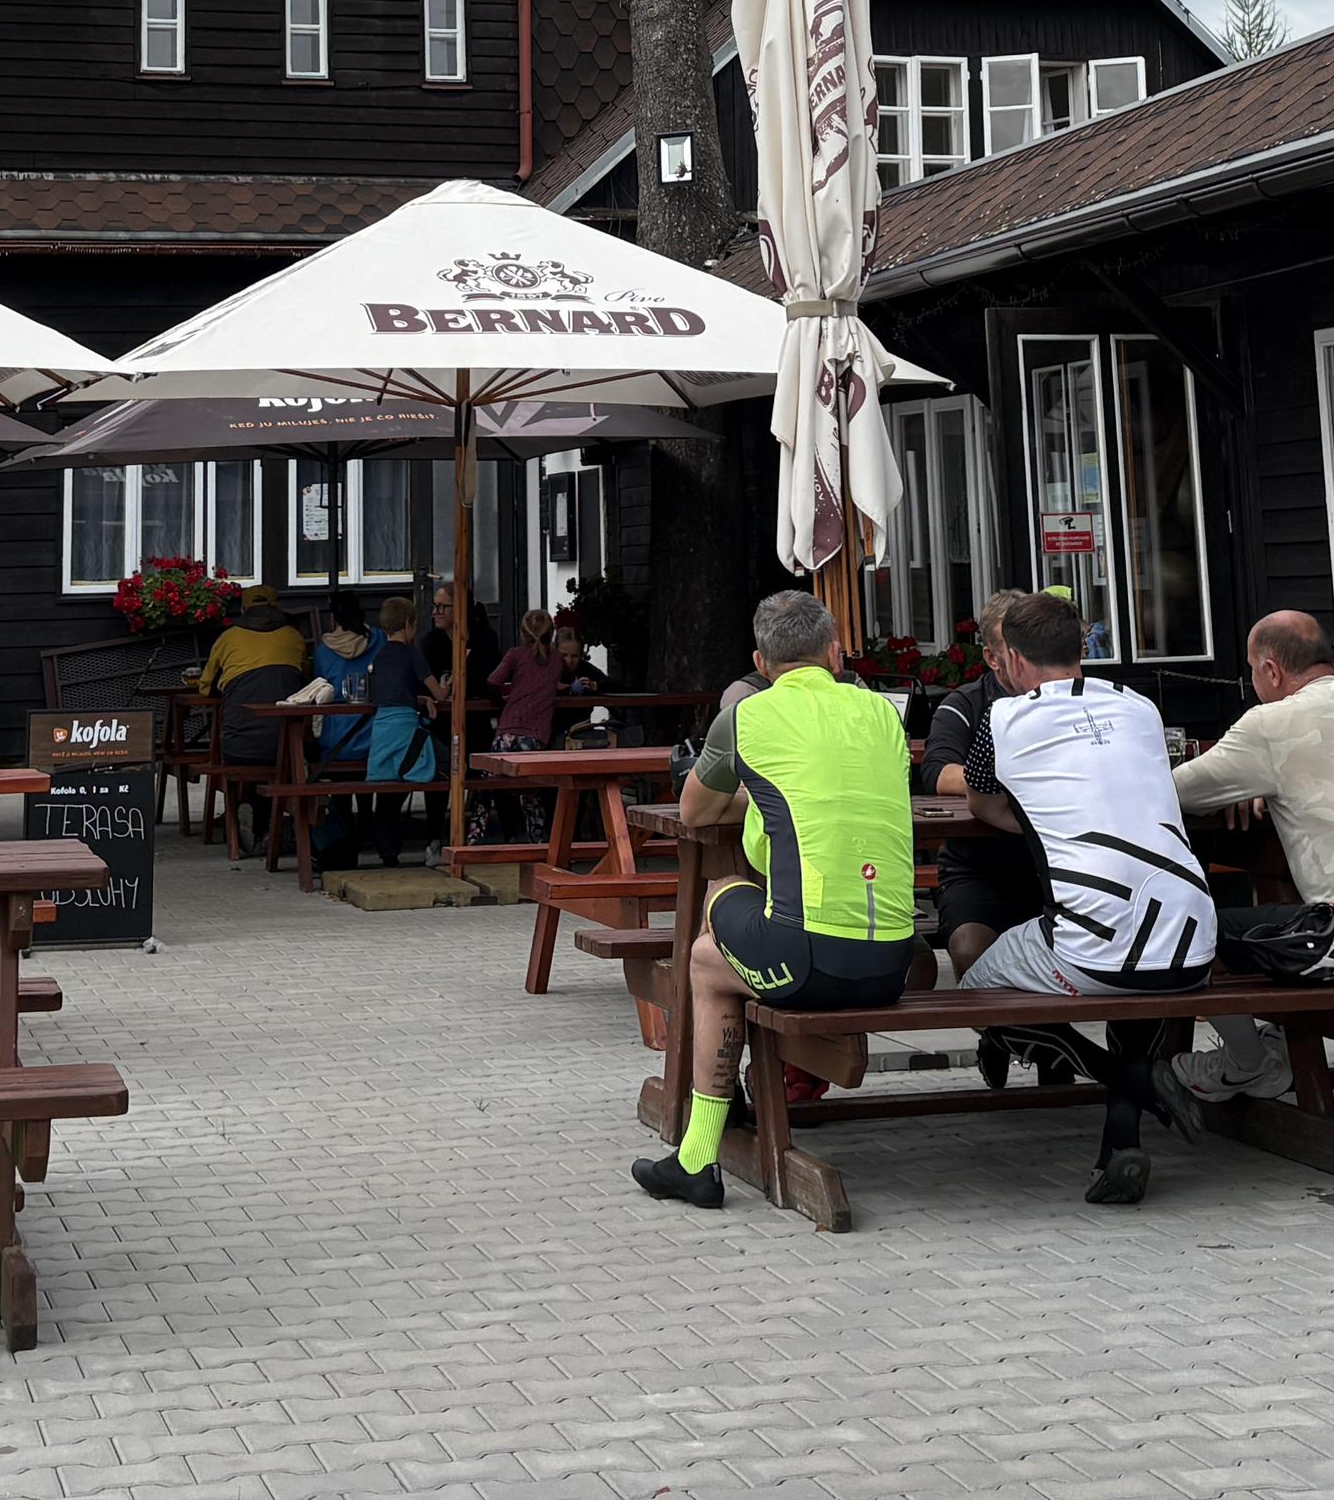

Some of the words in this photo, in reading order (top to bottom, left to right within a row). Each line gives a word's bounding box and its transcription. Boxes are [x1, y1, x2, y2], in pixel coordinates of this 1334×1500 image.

[361, 302, 707, 338] BERNARD
[70, 719, 127, 749] kofola
[51, 786, 76, 795] Kofola
[119, 784, 129, 793] Kč
[34, 803, 145, 840] TERASA
